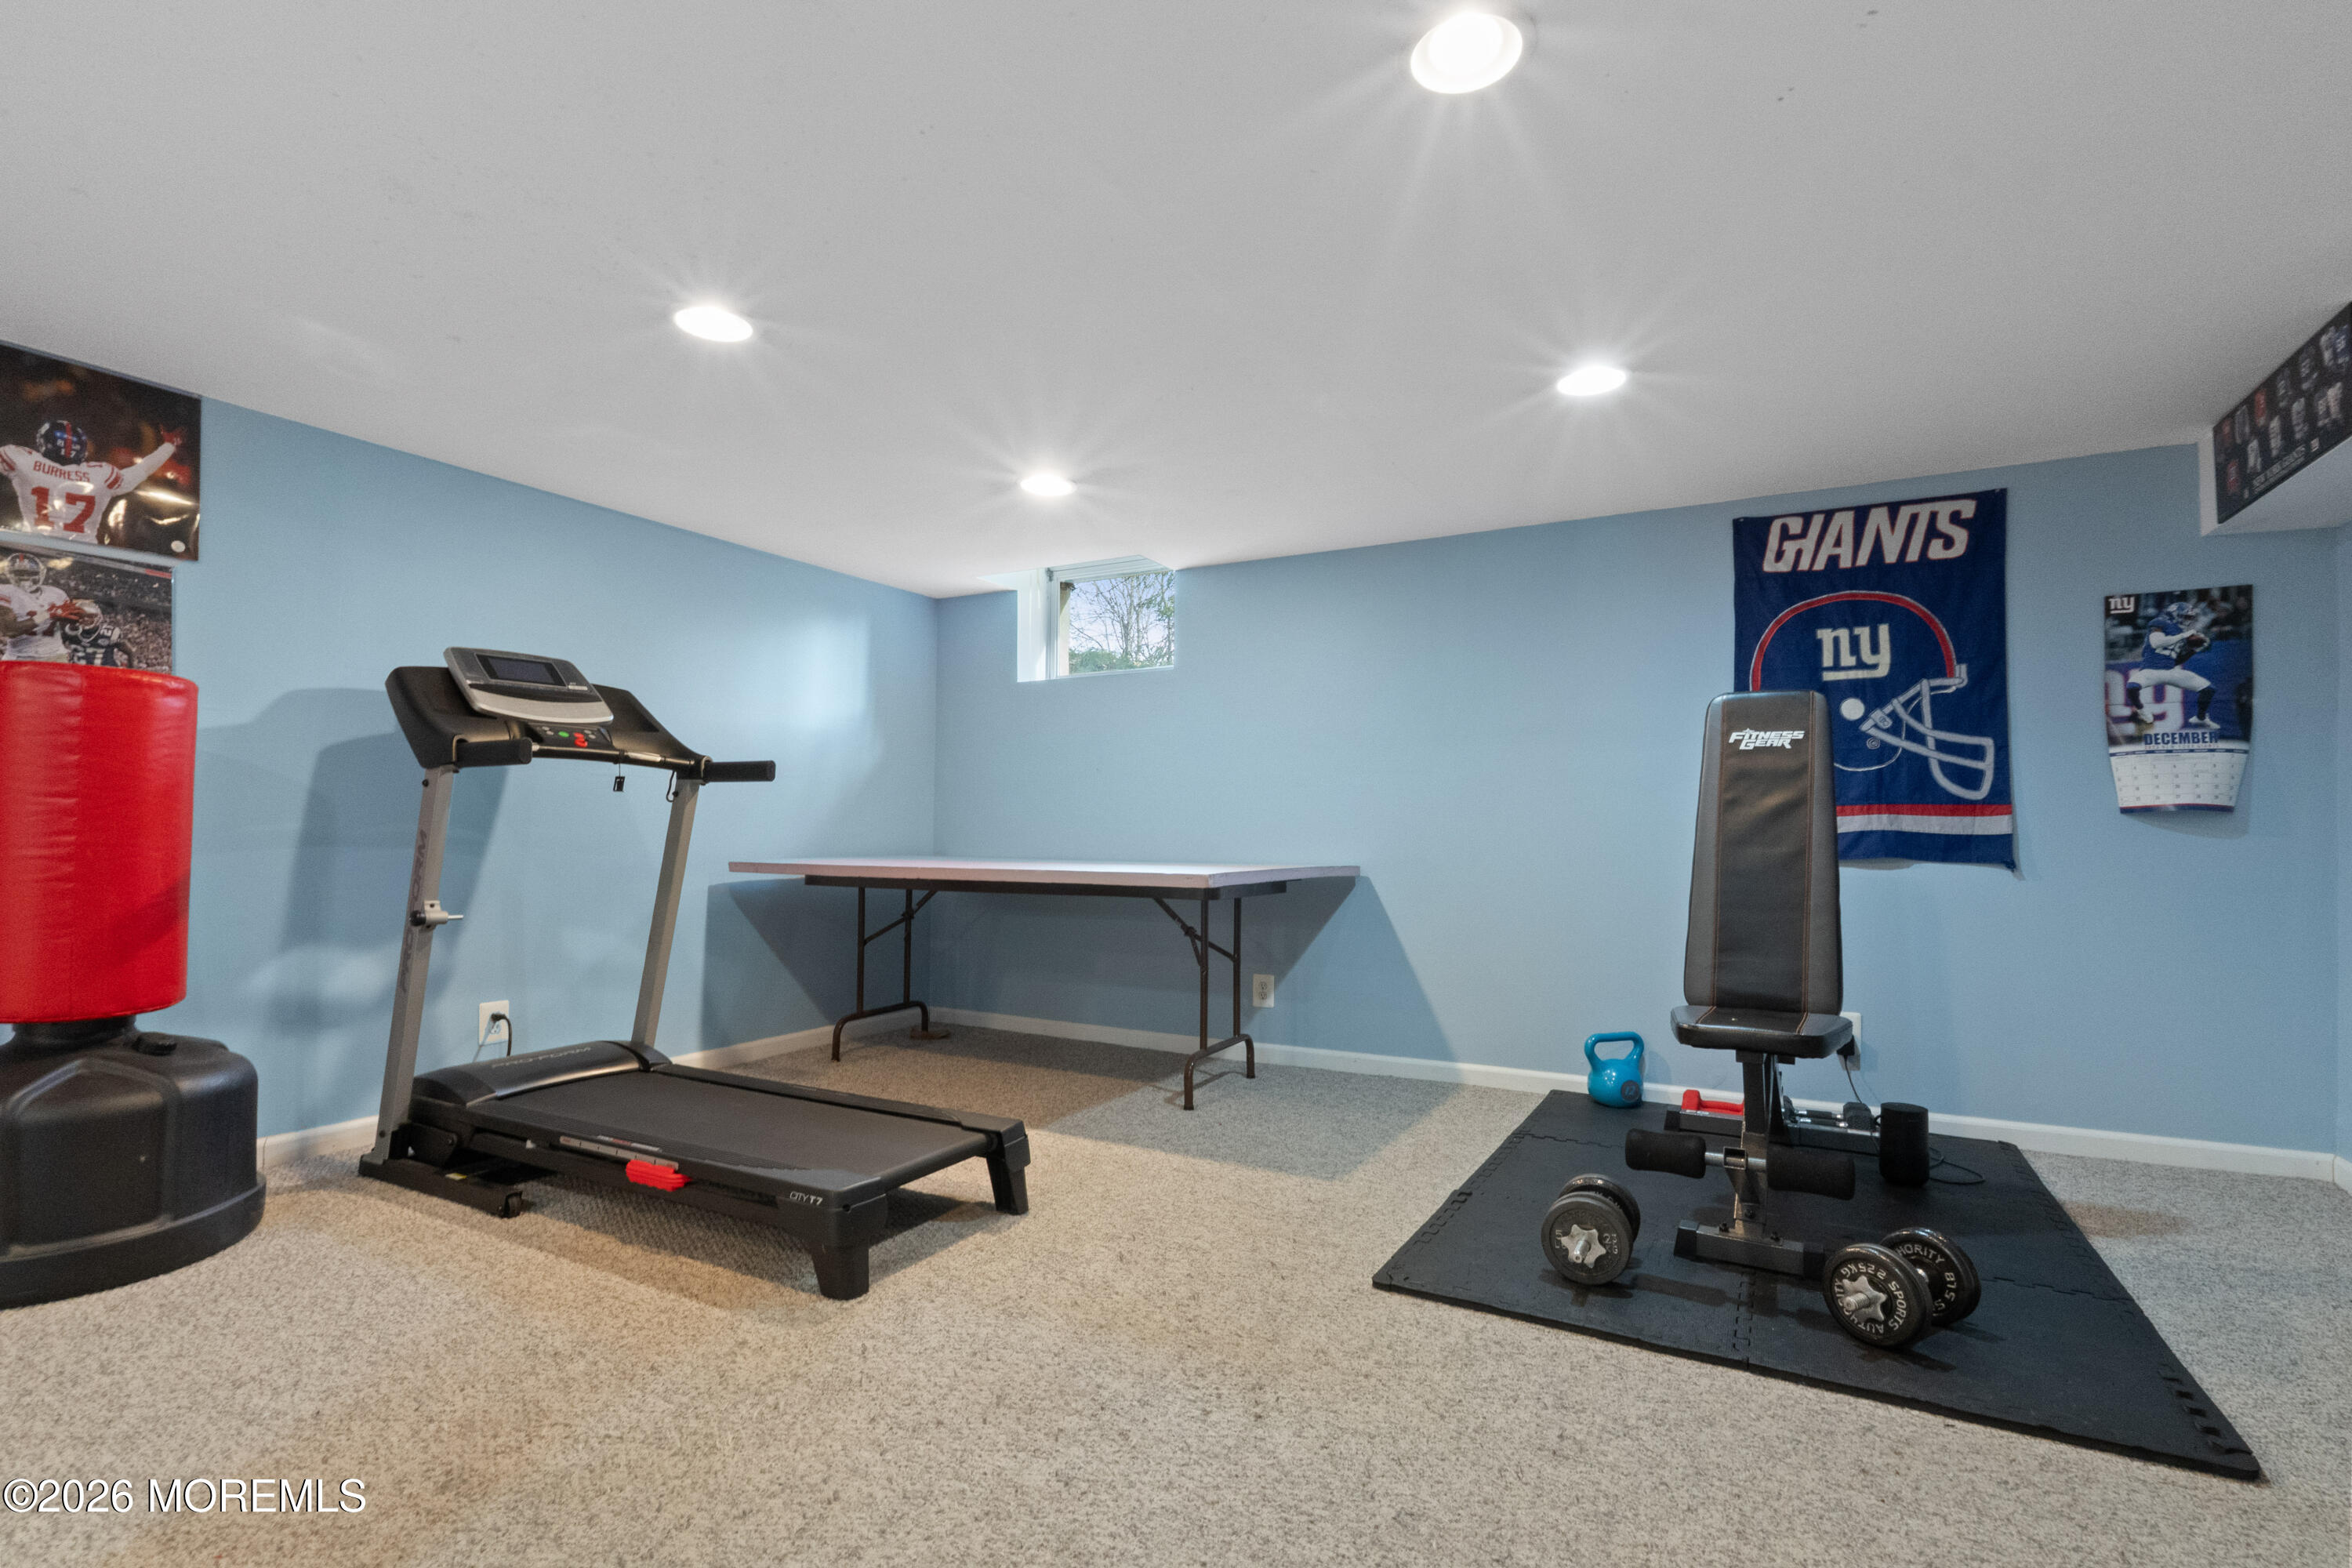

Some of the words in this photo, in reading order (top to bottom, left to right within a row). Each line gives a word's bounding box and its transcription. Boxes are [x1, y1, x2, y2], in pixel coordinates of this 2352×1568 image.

[34, 460, 91, 483] BURRESS
[31, 485, 96, 534] 17
[1762, 499, 1977, 574] GIANTS
[1728, 728, 1806, 743] FITNESS
[1739, 739, 1792, 750] GEAR
[2143, 731, 2220, 746] DECEMBER
[789, 1191, 809, 1202] CITY
[810, 1195, 823, 1206] T7
[1895, 1244, 1945, 1264] HORITY
[1888, 1280, 1907, 1330] SPORTS
